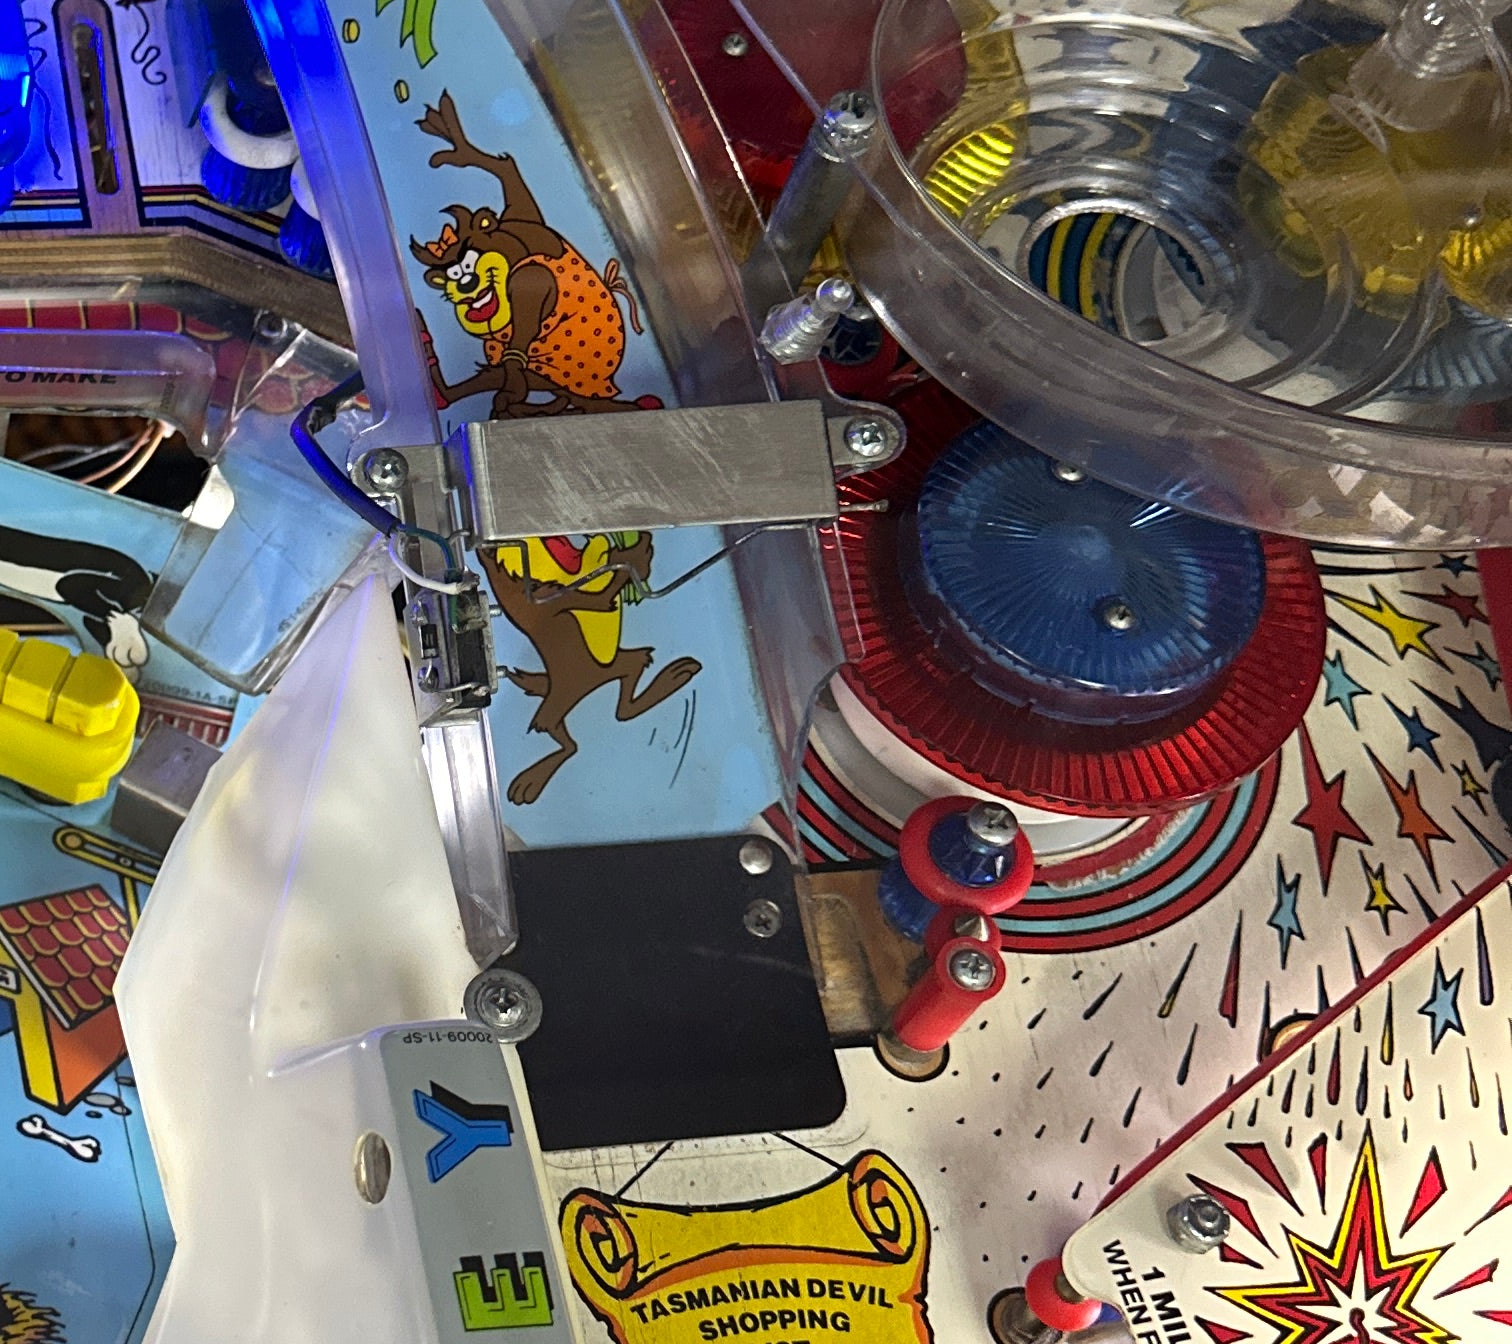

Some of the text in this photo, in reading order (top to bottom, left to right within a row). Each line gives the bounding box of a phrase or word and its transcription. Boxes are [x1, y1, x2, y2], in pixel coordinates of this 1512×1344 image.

[31, 371, 118, 386] MAKE
[1102, 1239, 1152, 1325] WHEN
[1142, 1266, 1166, 1282] 1
[630, 1278, 894, 1324] TASMANIAN DEVIL
[697, 1309, 851, 1342] SHOPPING
